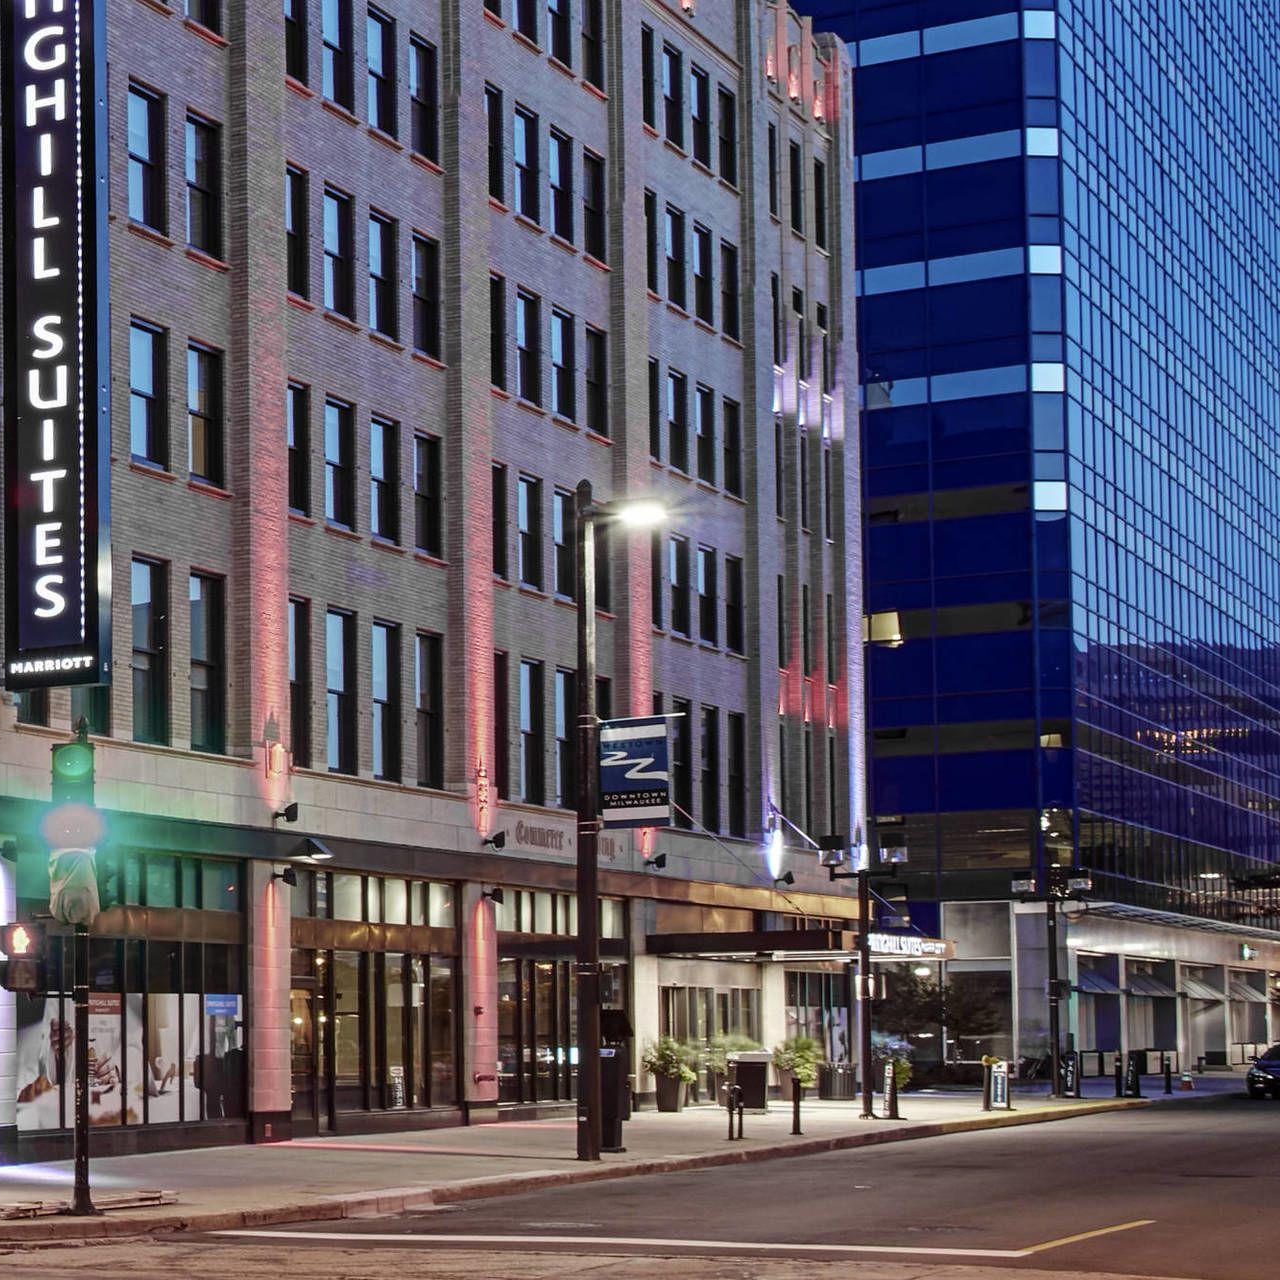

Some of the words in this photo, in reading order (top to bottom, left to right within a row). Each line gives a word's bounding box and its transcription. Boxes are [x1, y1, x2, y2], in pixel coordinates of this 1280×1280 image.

[28, 314, 67, 619] SUITES
[10, 656, 93, 674] MARRIOTT
[604, 792, 666, 801] DOWNTOWN
[609, 798, 661, 807] MILWAUKEE
